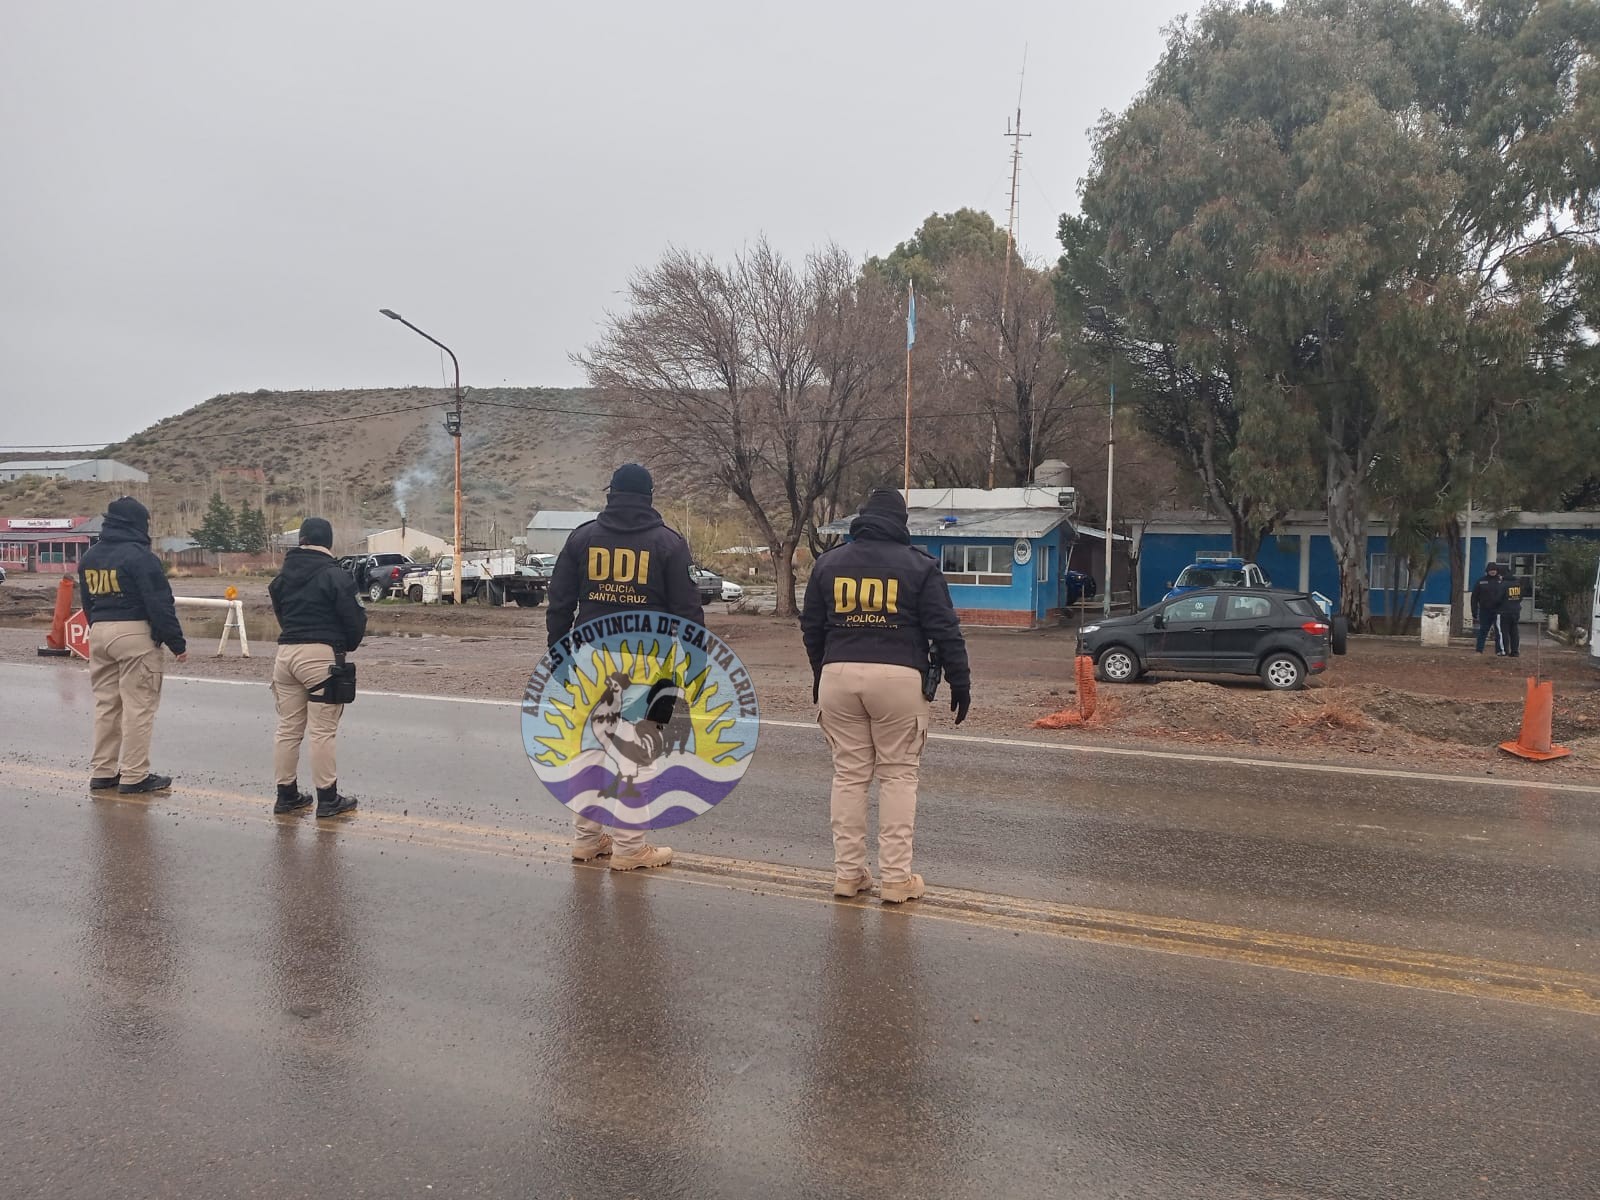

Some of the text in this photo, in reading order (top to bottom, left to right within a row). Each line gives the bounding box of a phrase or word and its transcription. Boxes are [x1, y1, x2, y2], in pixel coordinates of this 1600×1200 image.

[588, 547, 650, 585] DDI
[84, 569, 121, 595] DDI
[599, 583, 635, 593] POLICIA
[588, 592, 648, 604] SANTA CRUZ
[833, 577, 898, 613] DDI
[845, 614, 887, 623] POLICIA
